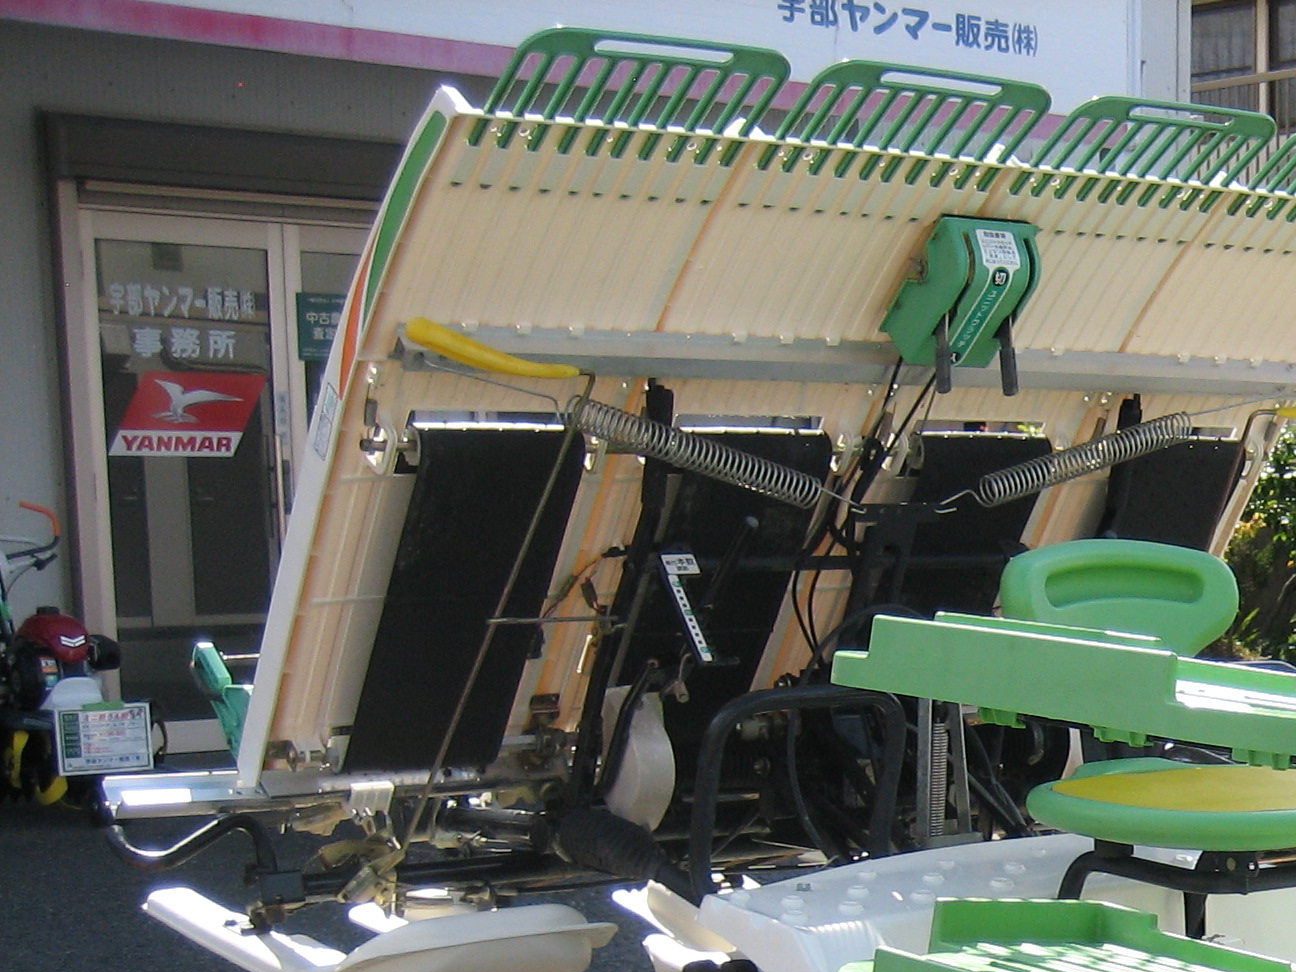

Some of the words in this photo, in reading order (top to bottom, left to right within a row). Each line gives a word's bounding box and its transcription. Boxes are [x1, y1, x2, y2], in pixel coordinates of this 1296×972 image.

[132, 327, 237, 360] 事務所
[121, 434, 233, 453] YANMAR
